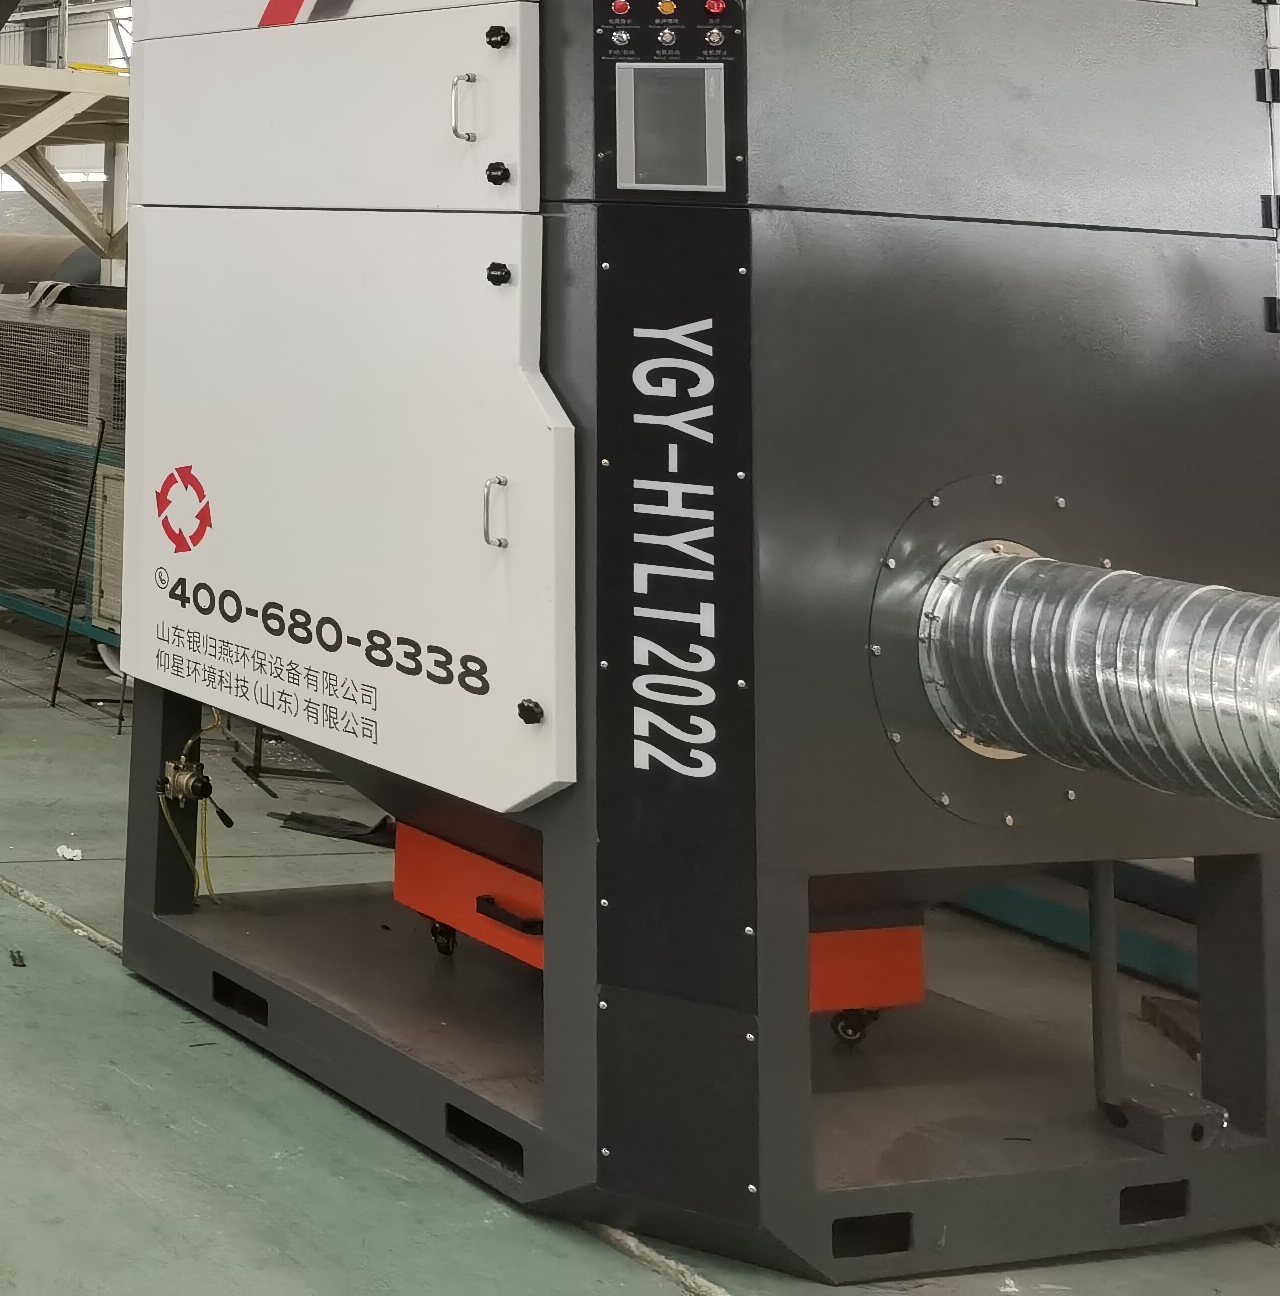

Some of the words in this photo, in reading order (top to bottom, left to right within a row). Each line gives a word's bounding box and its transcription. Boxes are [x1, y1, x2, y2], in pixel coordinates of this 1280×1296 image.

[632, 318, 717, 779] YGY-HYLT2022
[156, 620, 378, 711] 山东银归燕环保设备有限公司
[168, 577, 490, 696] 400-680-8338
